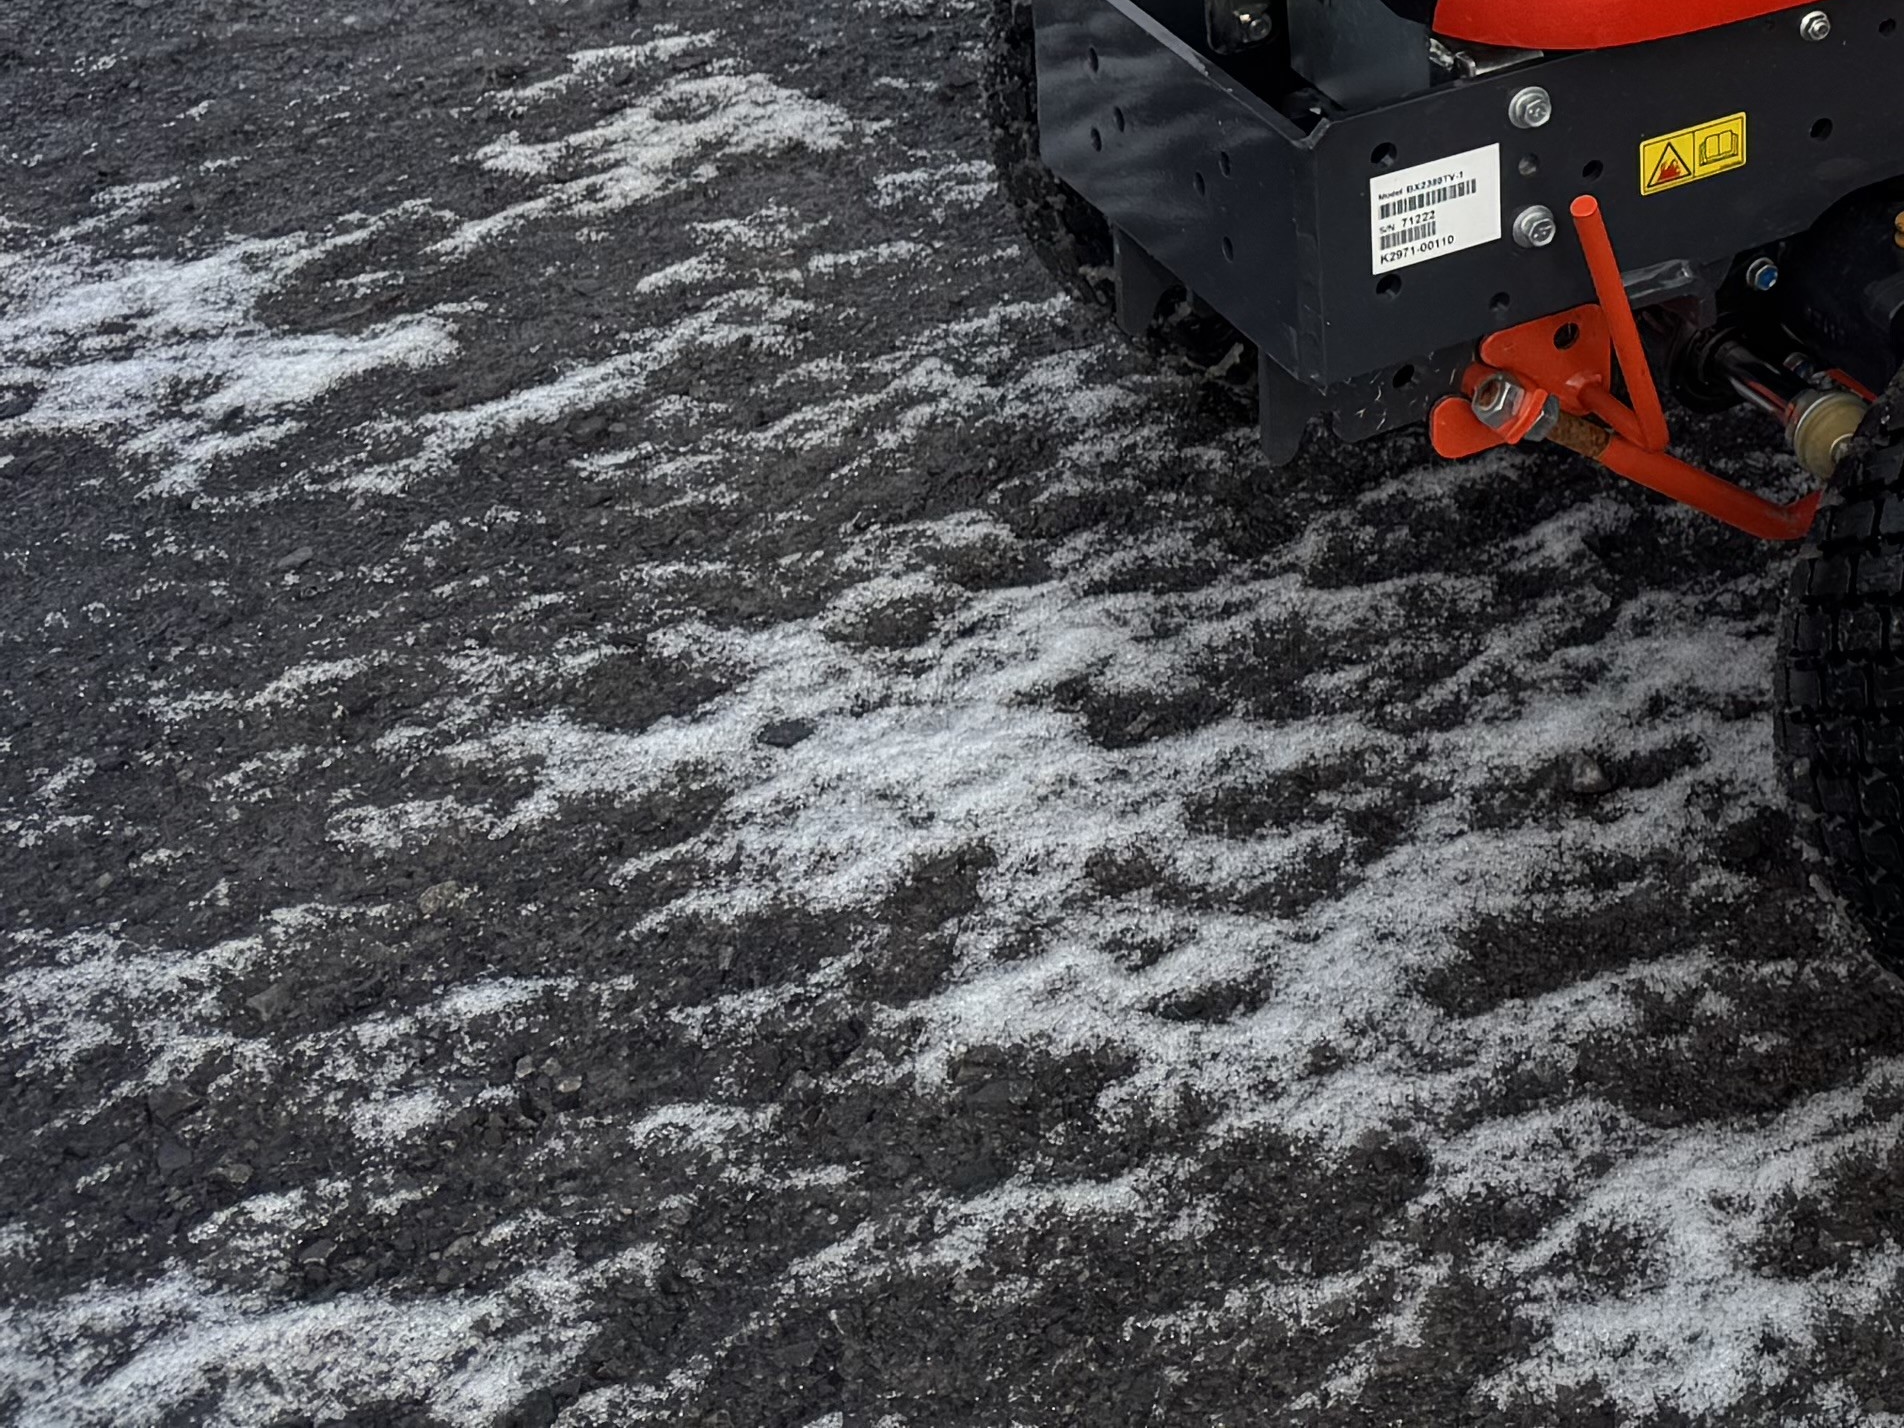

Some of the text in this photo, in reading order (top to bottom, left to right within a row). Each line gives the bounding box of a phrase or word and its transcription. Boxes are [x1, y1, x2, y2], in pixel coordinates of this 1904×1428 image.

[1378, 171, 1465, 201] Model BX2380TV-1
[1402, 210, 1436, 227] 71222
[1380, 234, 1455, 265] K2971-00110
